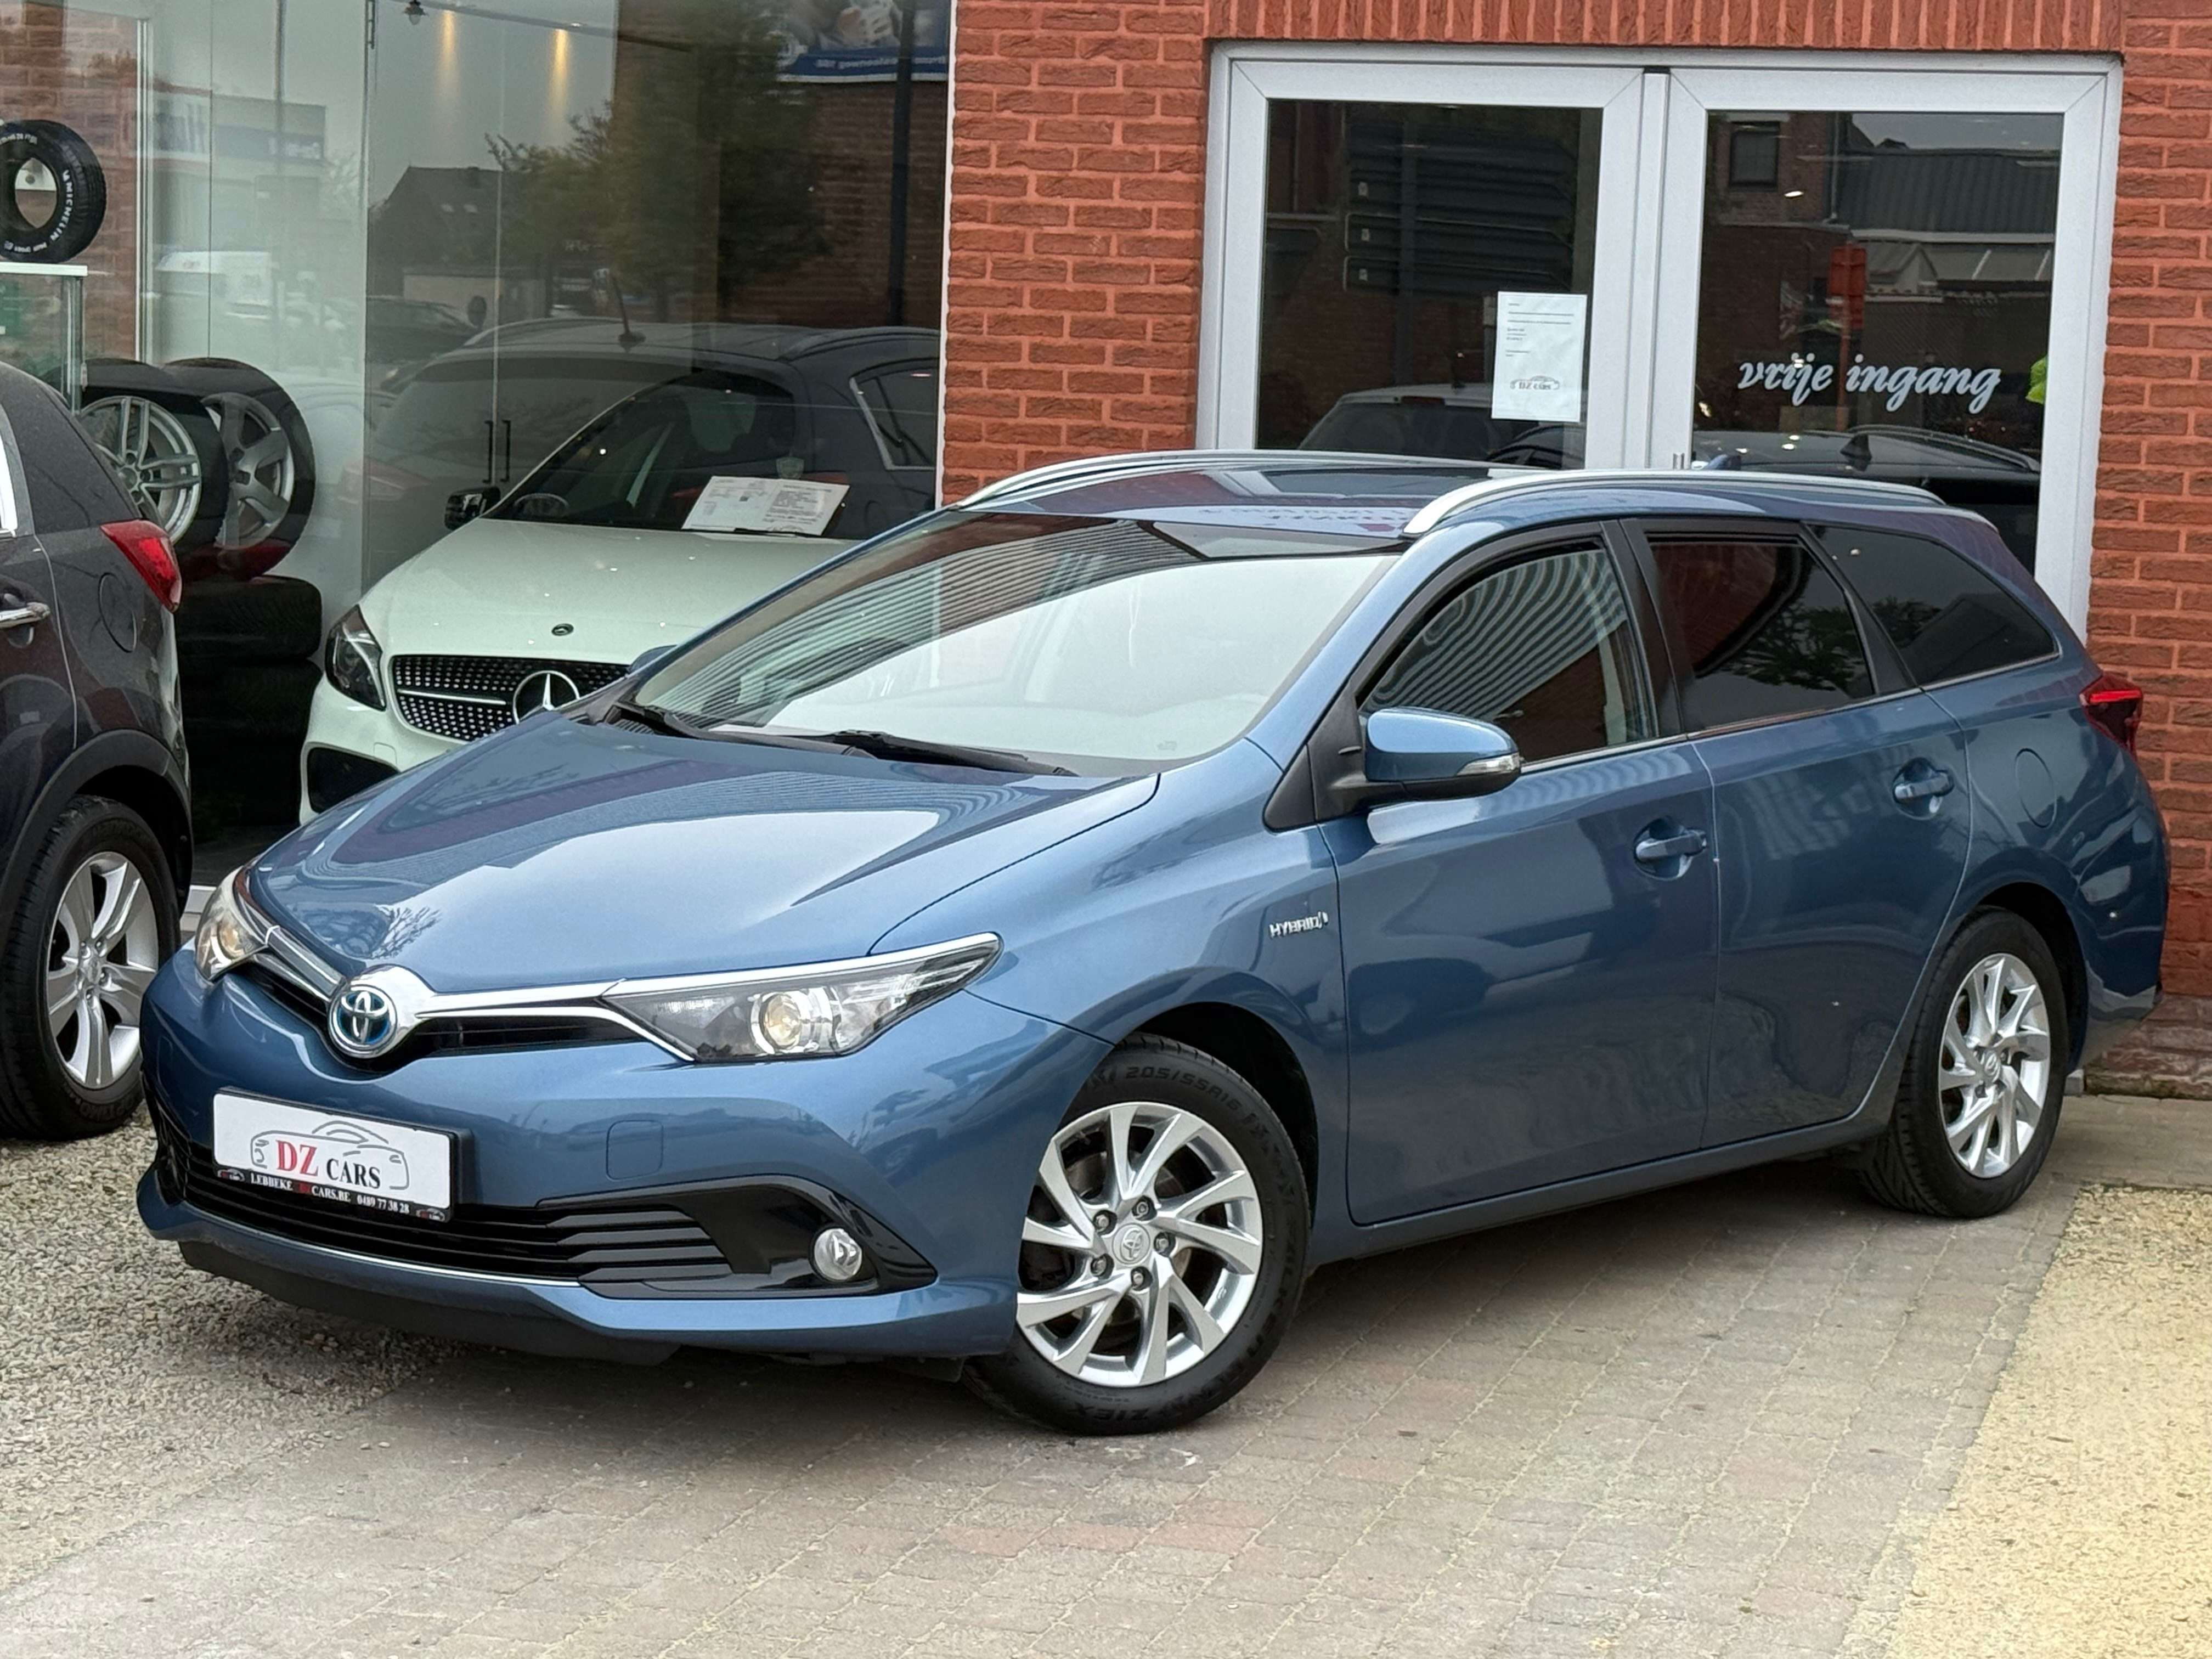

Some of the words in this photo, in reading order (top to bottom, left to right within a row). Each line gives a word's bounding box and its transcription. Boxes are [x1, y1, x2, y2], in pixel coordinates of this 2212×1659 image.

[50, 181, 75, 242] MICHELIN
[1737, 353, 1834, 407] vrije
[1844, 353, 2002, 414] ingang
[1269, 915, 1322, 938] HYBRID
[276, 1139, 319, 1176] DZ
[326, 1158, 381, 1189] CARS
[251, 1172, 293, 1191] LEBBEKE
[377, 1198, 387, 1209] 77
[388, 1200, 398, 1212] 38
[399, 1203, 410, 1214] 28
